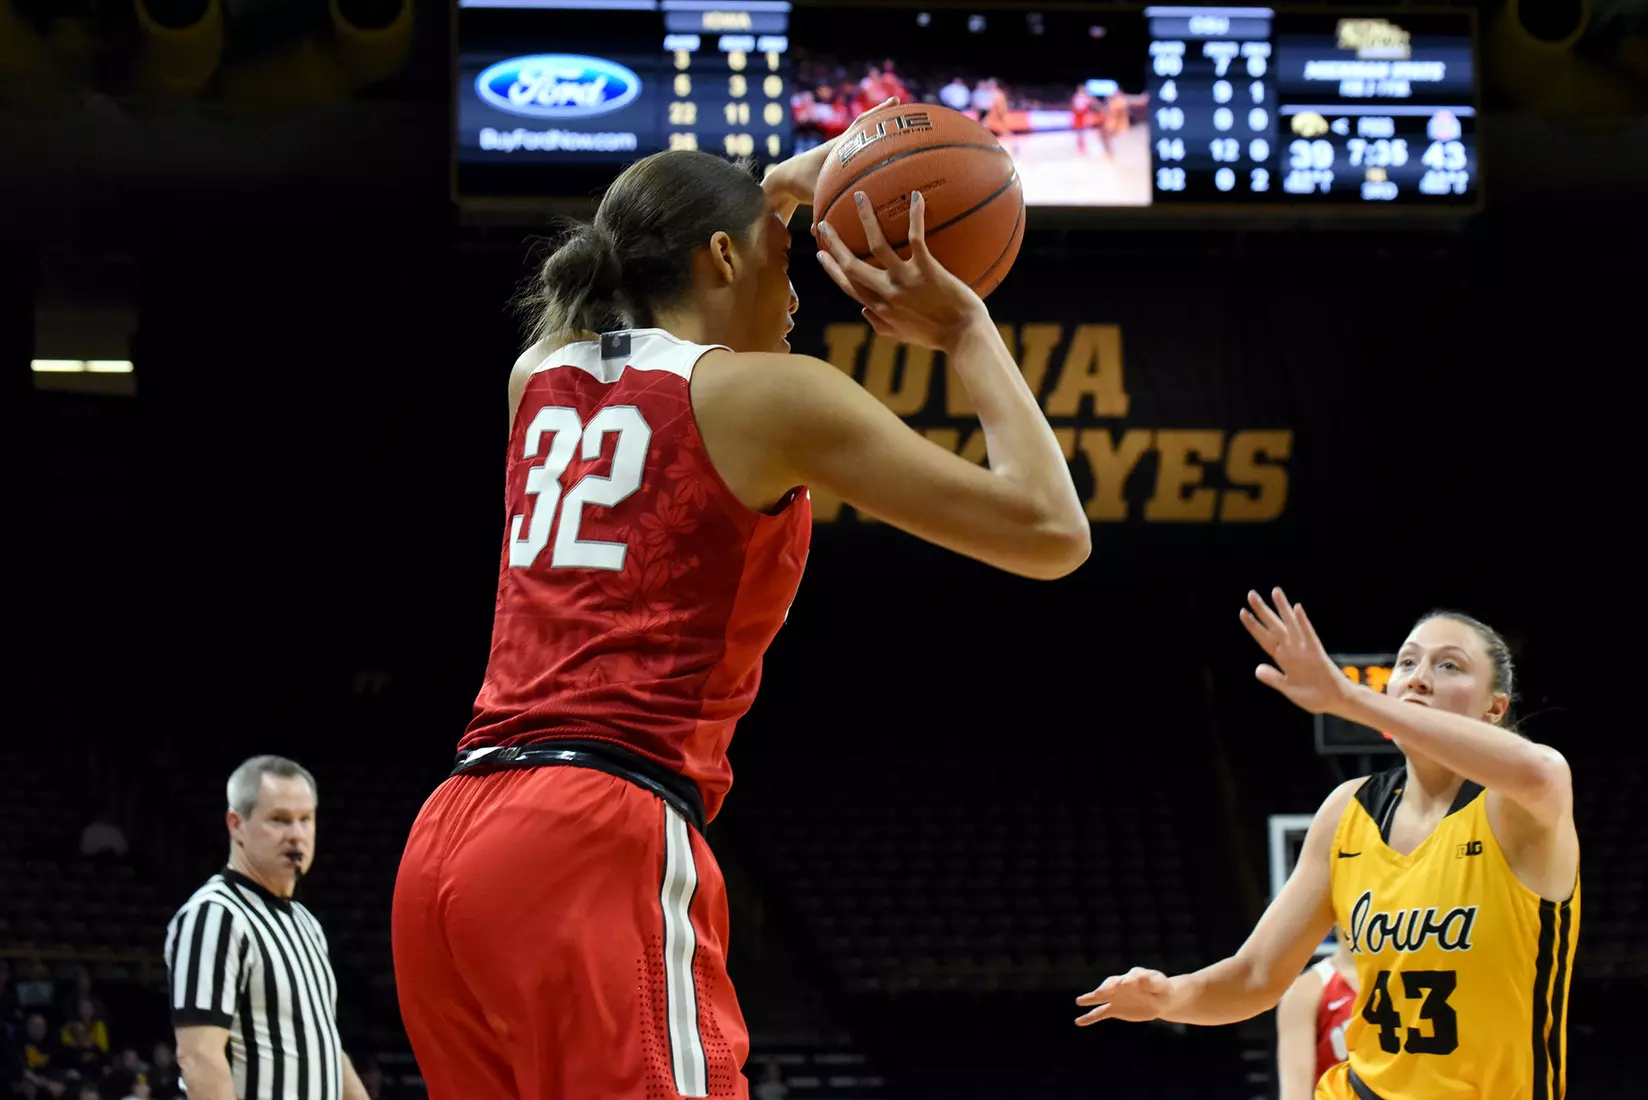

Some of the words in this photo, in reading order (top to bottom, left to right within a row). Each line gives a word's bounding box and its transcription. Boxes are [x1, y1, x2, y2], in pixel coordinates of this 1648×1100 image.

[508, 63, 607, 106] Ford
[479, 128, 637, 152] BuyFordNow.com
[839, 111, 932, 163] ELITE
[1422, 141, 1466, 170] 43
[509, 404, 652, 571] 32
[1344, 888, 1478, 954] Iowa
[1361, 970, 1459, 1055] 43
